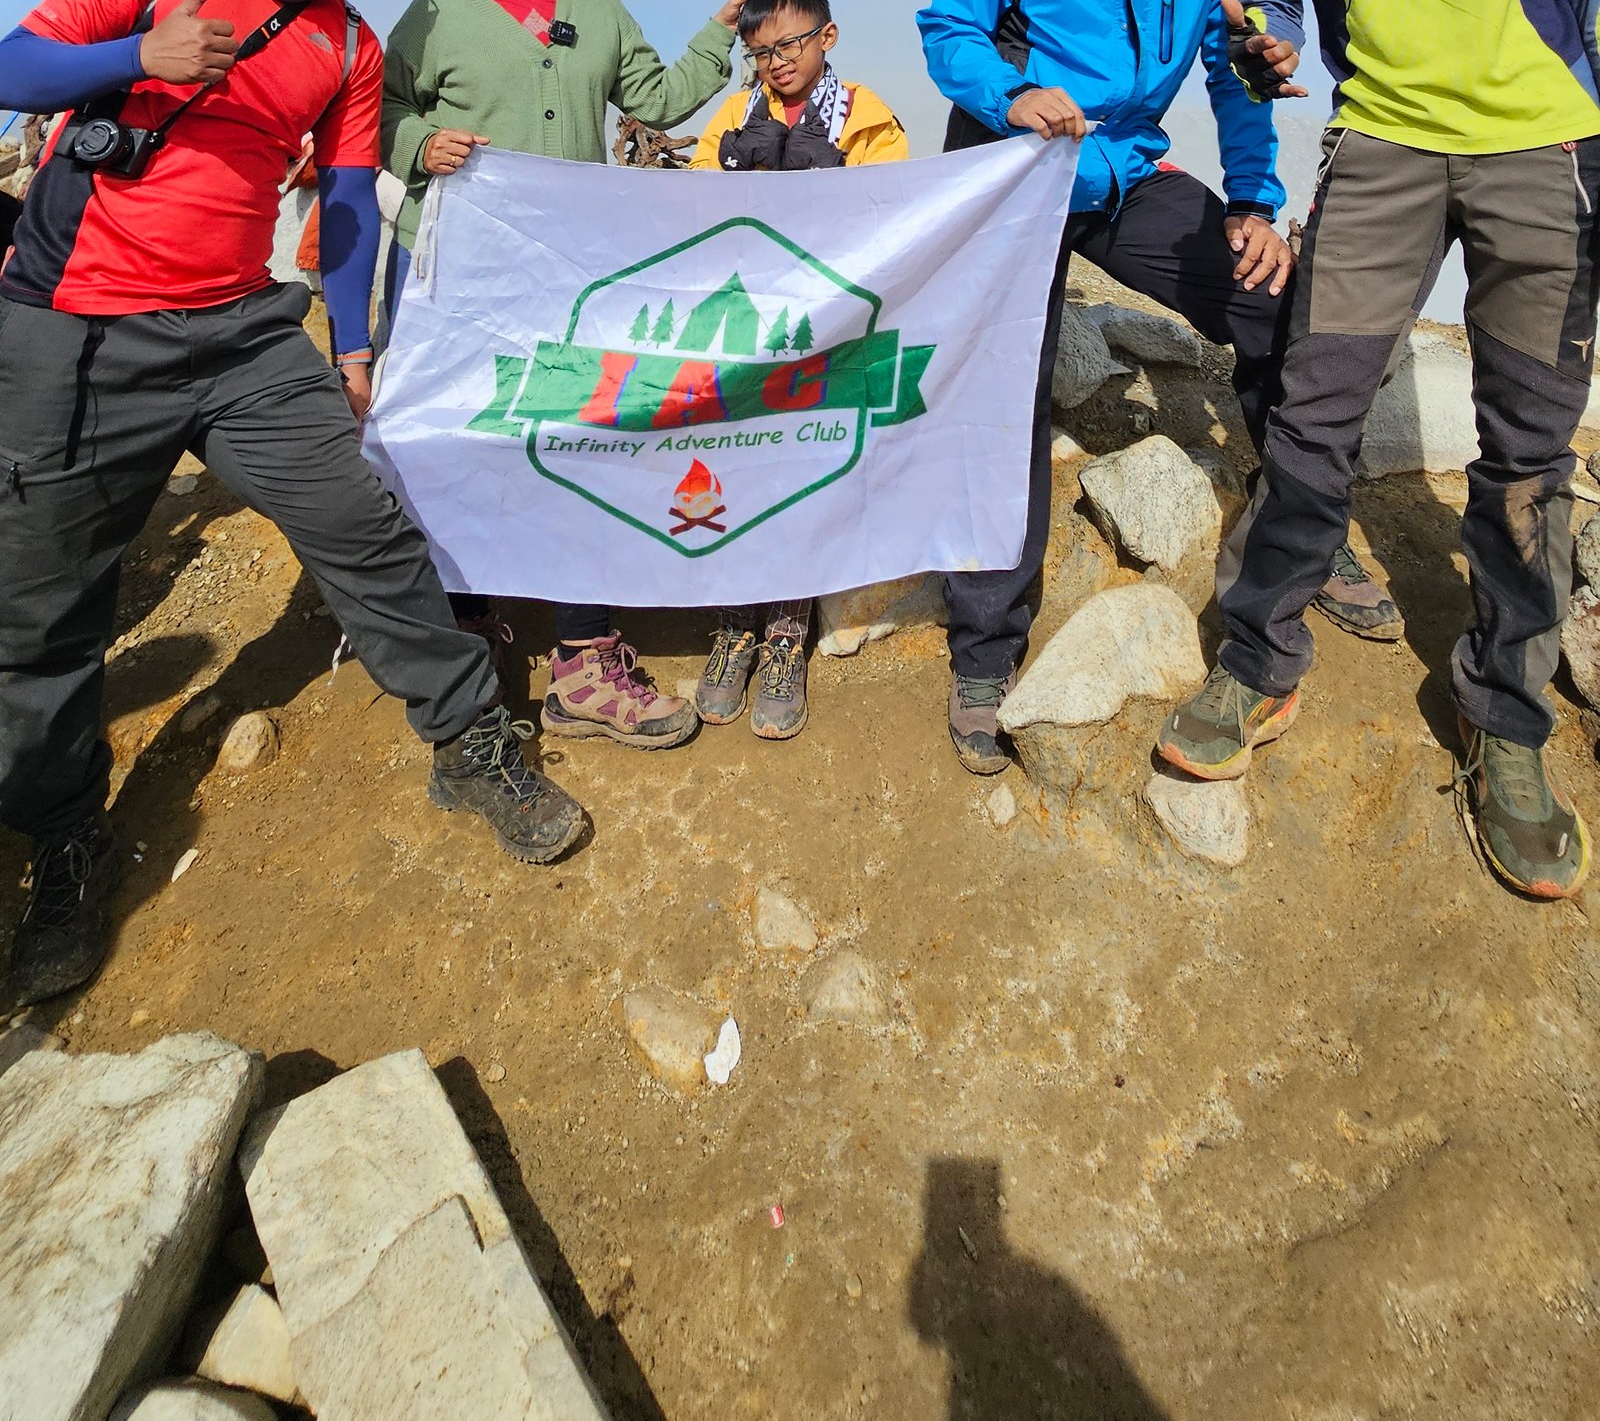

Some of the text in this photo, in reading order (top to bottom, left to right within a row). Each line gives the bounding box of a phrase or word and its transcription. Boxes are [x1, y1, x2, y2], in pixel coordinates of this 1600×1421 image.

[578, 352, 830, 429] IAC
[542, 420, 848, 458] Infinity Adventure Club
